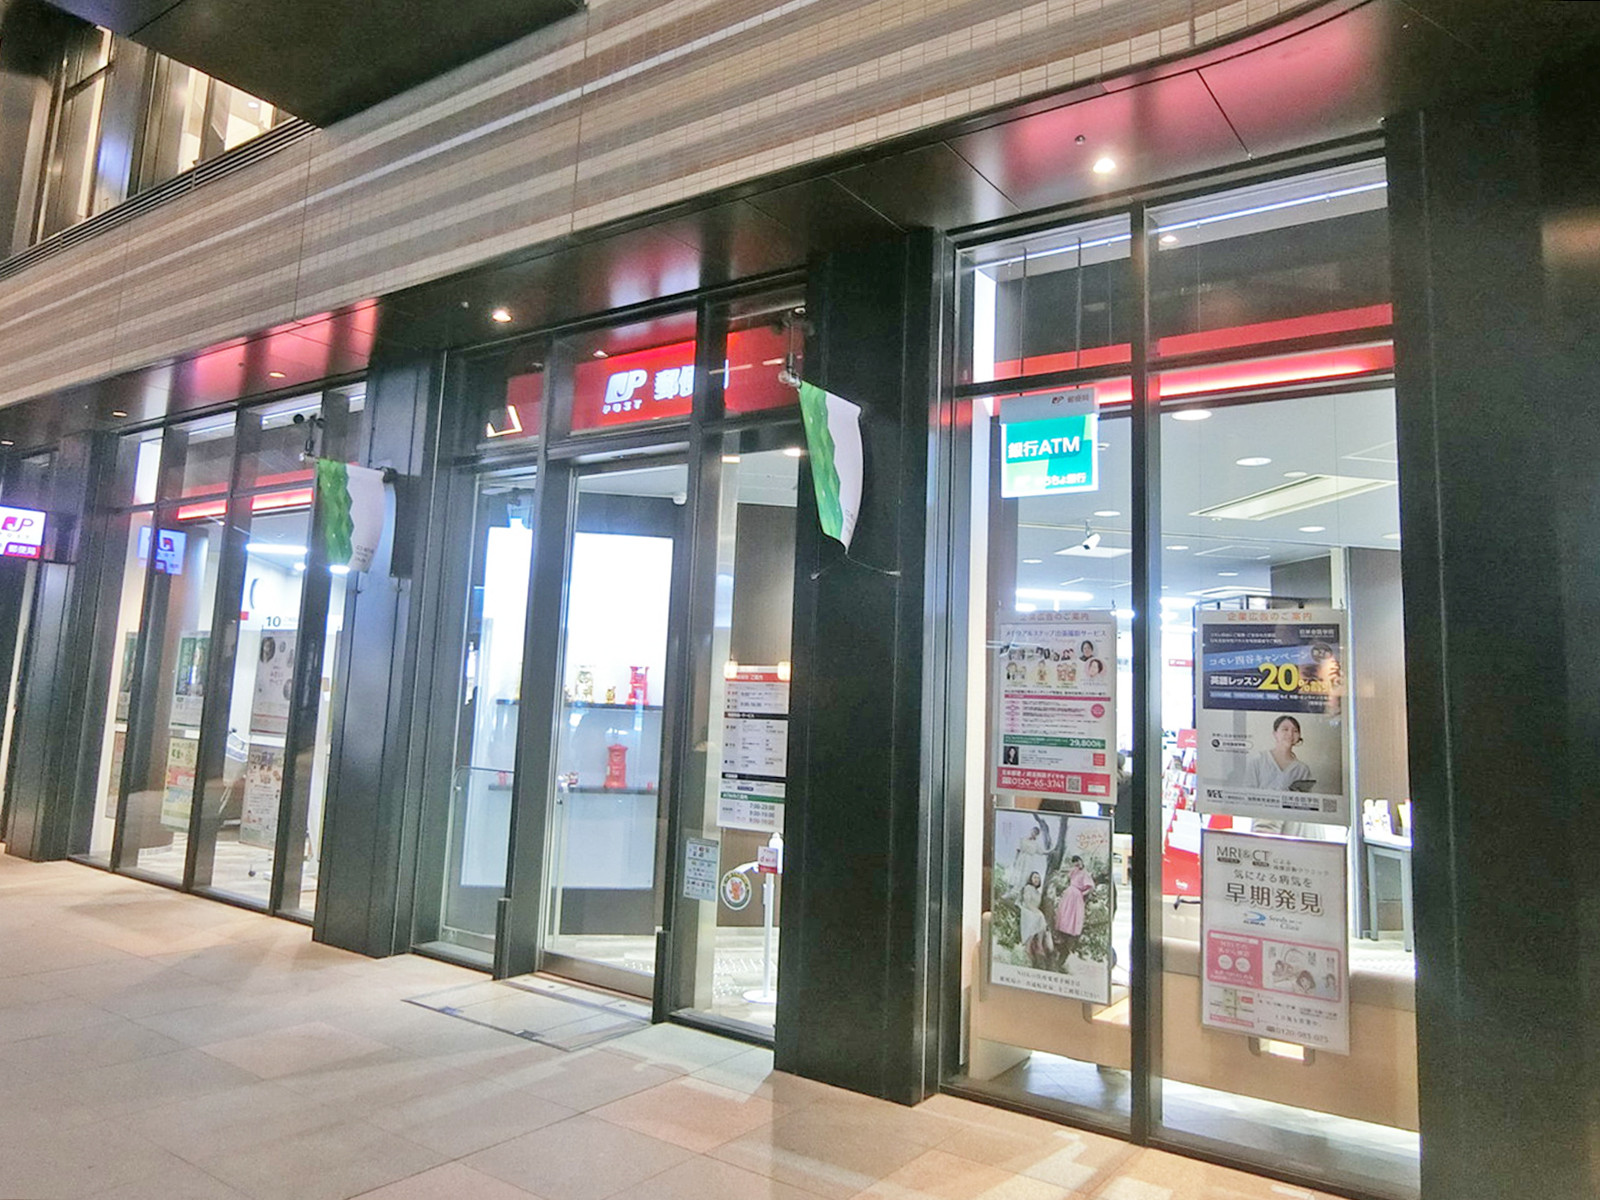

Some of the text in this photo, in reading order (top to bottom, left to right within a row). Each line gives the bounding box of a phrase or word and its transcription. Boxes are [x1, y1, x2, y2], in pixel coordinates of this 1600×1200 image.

[602, 399, 643, 415] POST
[1007, 435, 1081, 459] 銀行ATM
[266, 616, 282, 627] 10
[1227, 611, 1312, 622] 企業広告のご案内
[1209, 650, 1308, 666] コモレ四谷キャンペーン
[1234, 869, 1313, 888] 気になる病気を
[1226, 882, 1321, 914] 早期発見
